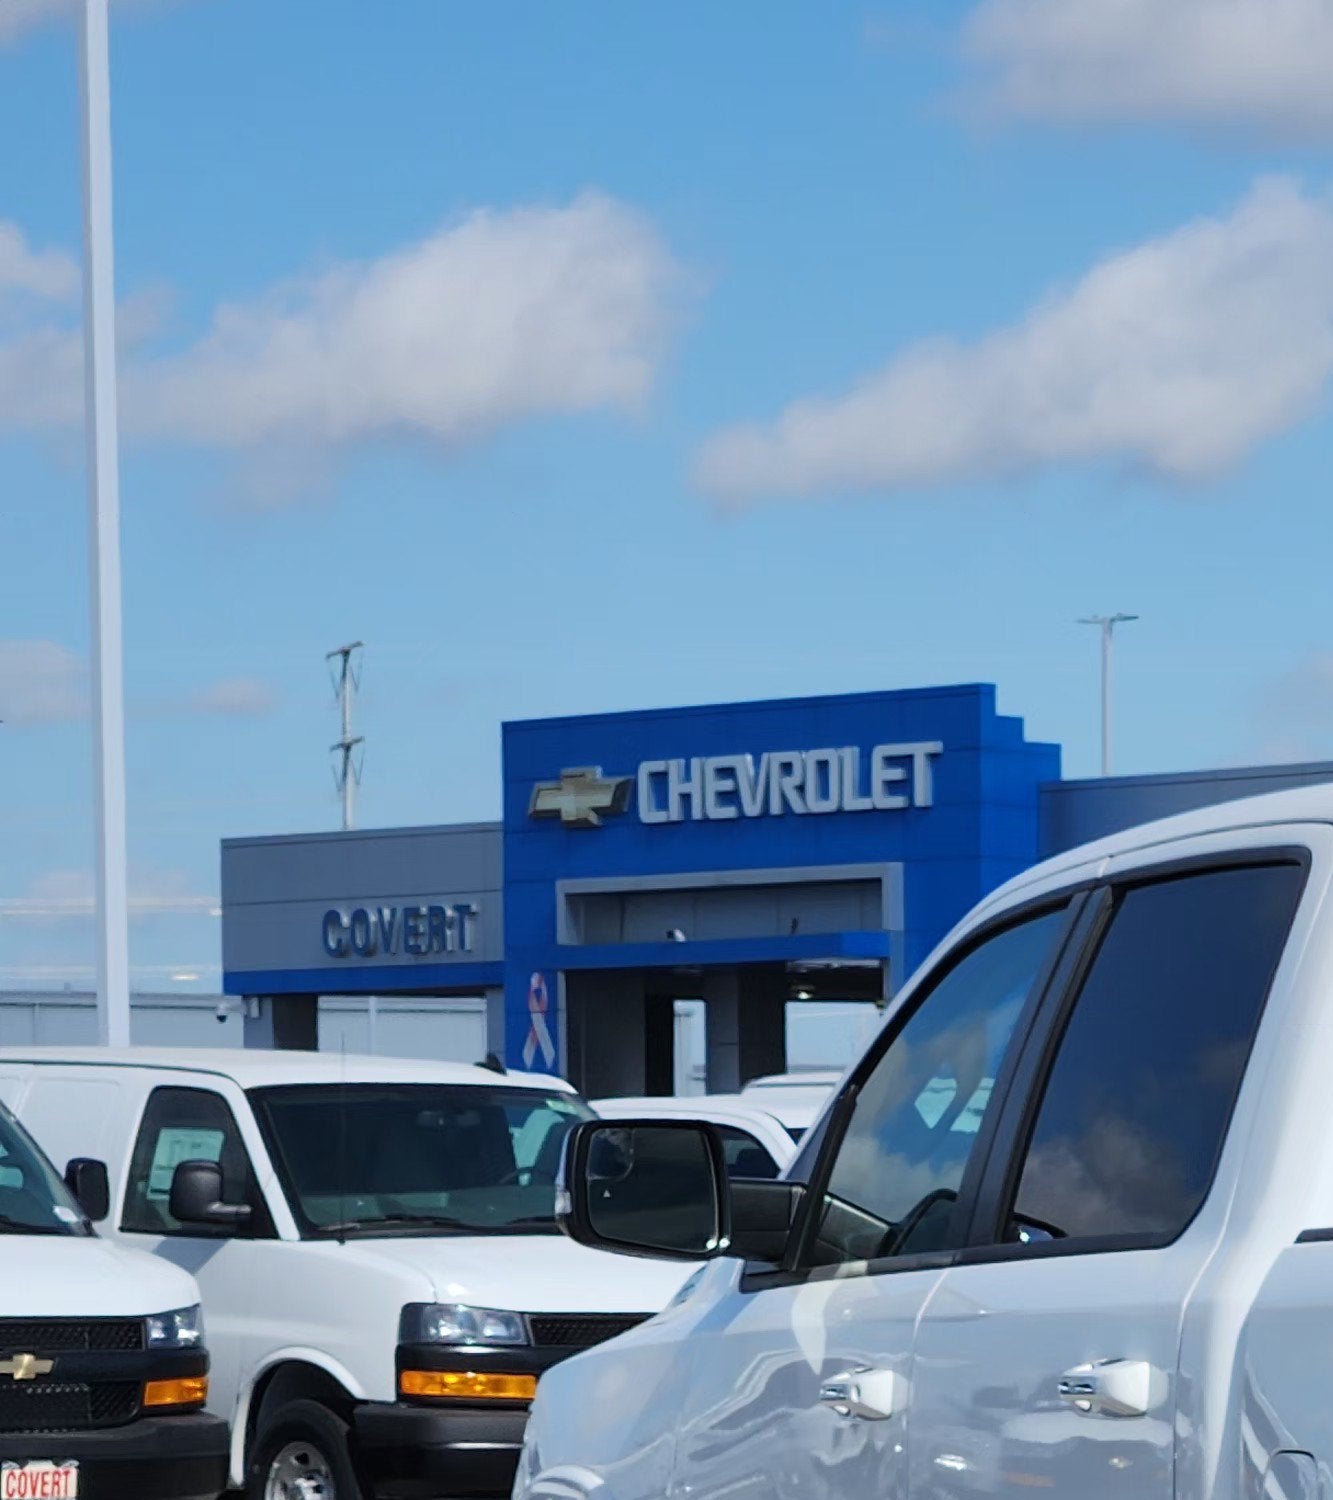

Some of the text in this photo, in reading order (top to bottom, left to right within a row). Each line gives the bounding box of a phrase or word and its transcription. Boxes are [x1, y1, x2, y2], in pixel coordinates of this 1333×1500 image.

[638, 741, 944, 823] CHEVROLET
[322, 903, 479, 958] COVERT
[6, 1469, 71, 1498] COVERT
